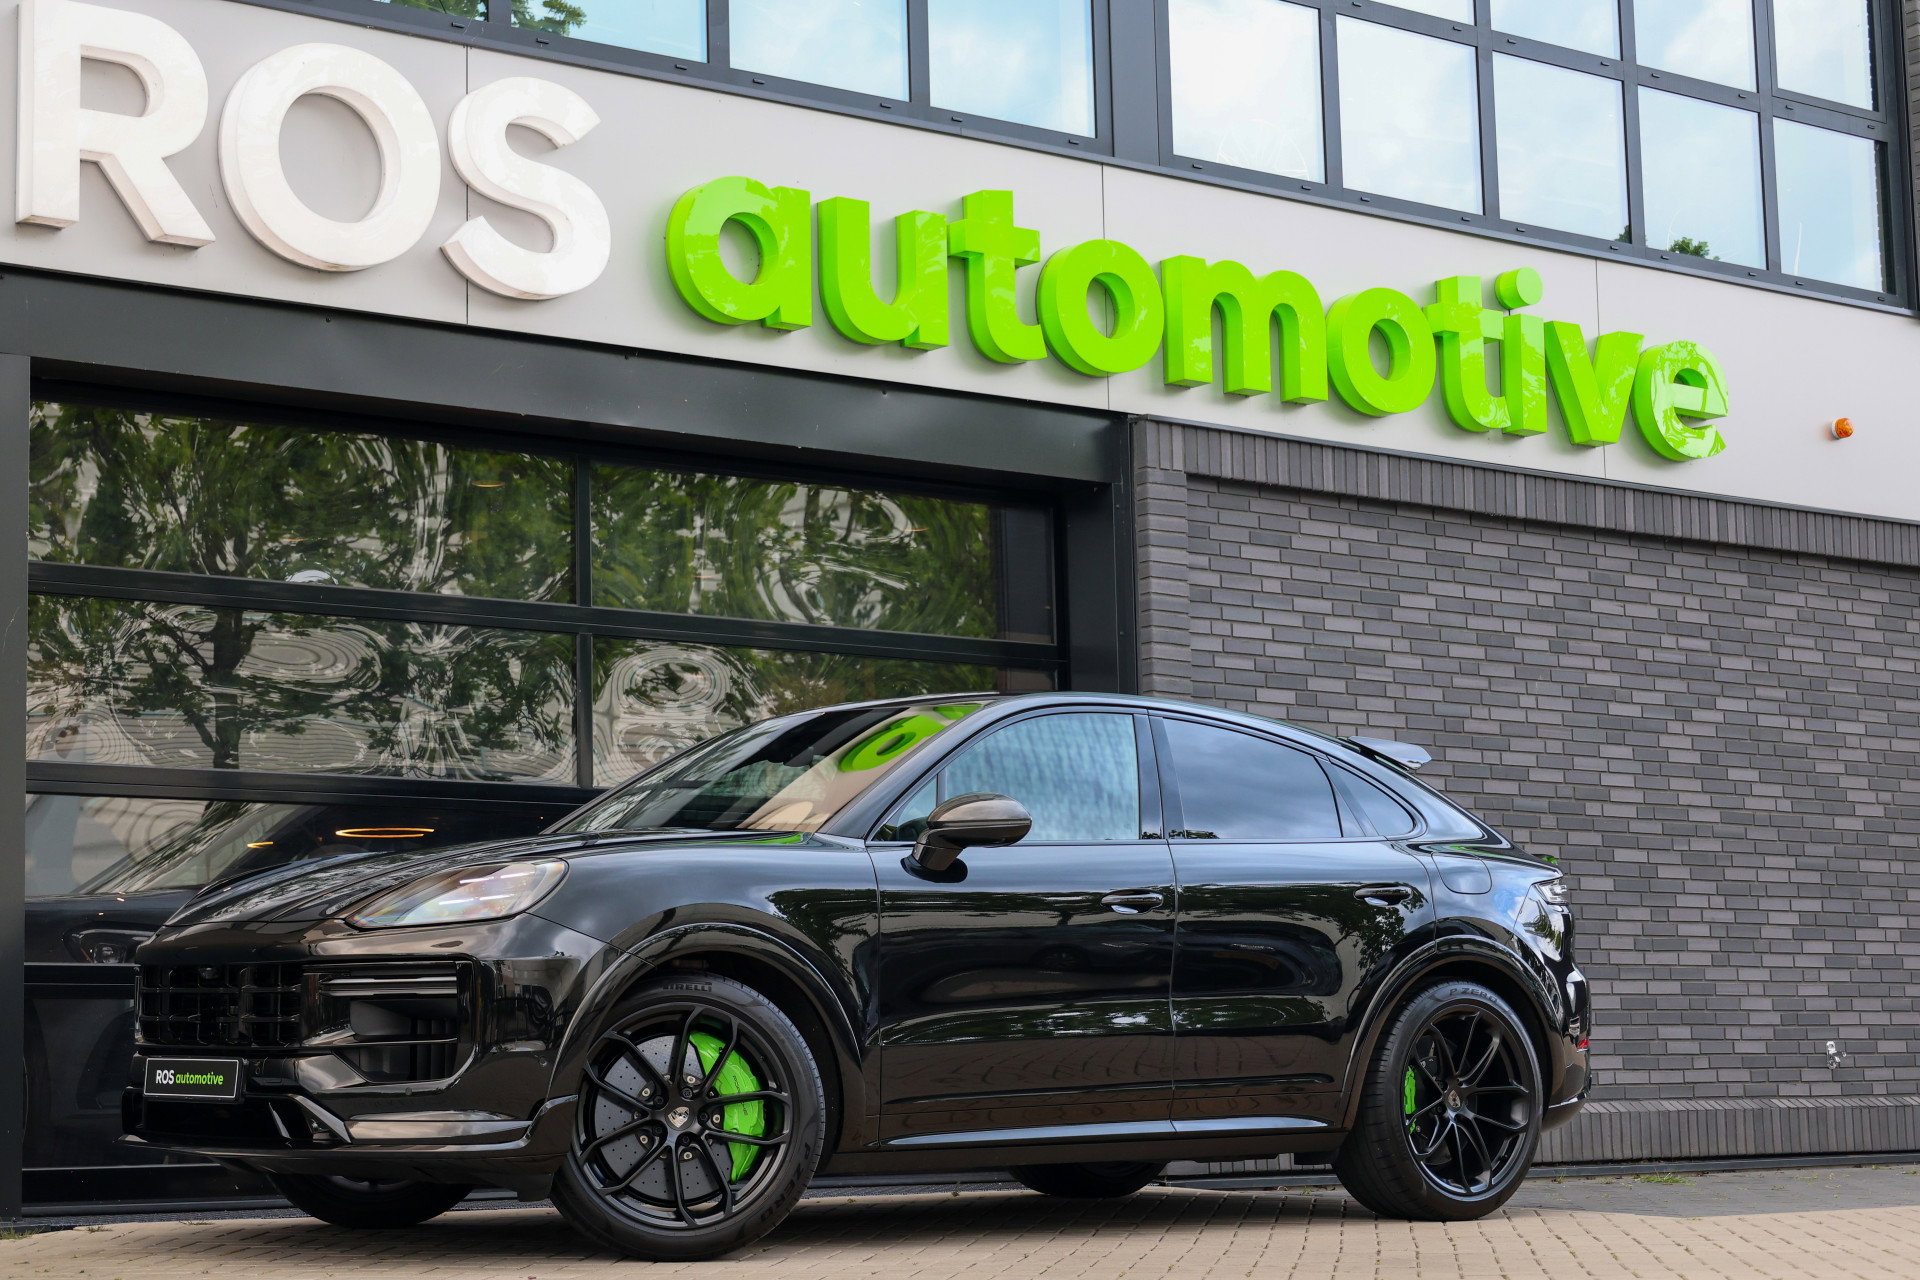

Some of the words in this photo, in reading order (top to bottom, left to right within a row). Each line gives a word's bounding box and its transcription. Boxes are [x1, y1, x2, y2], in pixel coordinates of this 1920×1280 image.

[15, 0, 611, 300] ROS
[665, 175, 1729, 462] automotive
[155, 1069, 175, 1084] ROS
[176, 1072, 224, 1085] automotive
